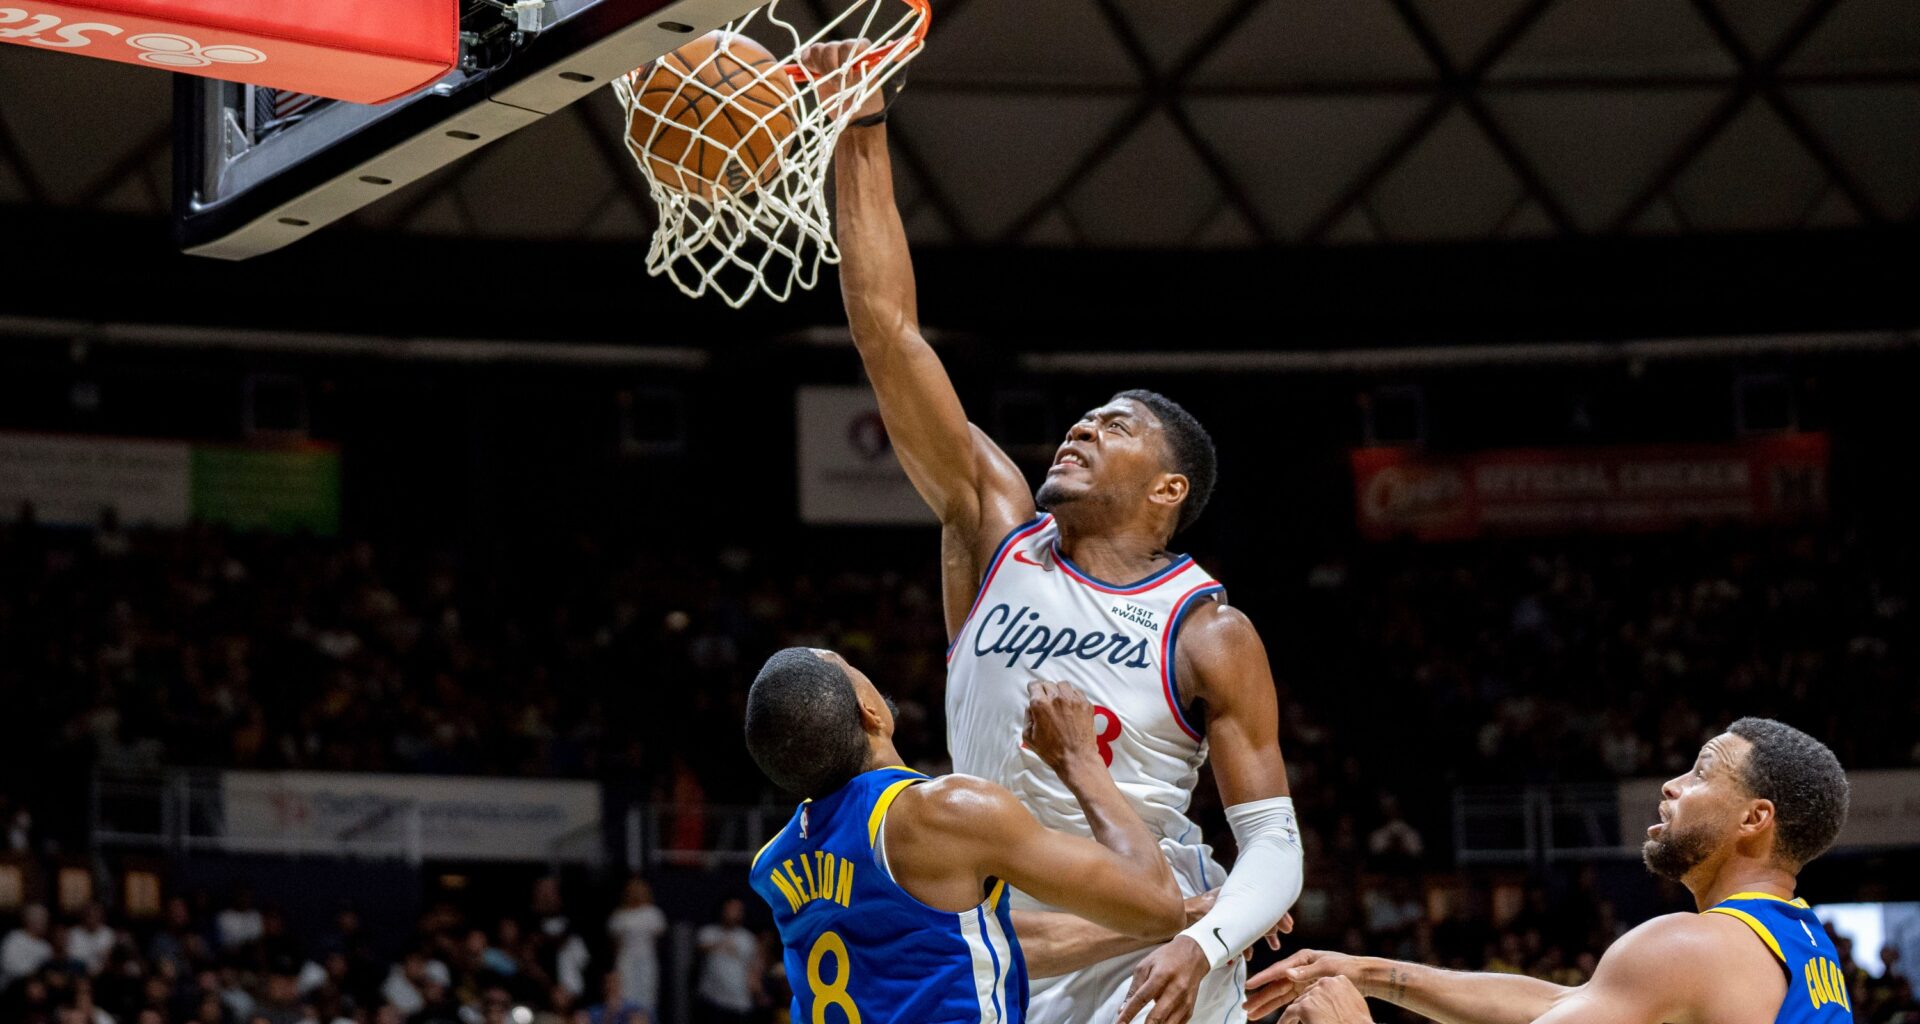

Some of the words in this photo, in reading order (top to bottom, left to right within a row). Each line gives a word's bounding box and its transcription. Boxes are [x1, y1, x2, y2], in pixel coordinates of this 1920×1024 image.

[975, 603, 1151, 669] Clippers
[1111, 606, 1158, 631] RWANDA
[1126, 603, 1154, 619] VISIT
[770, 850, 855, 914] MELTON
[807, 931, 862, 1024] 8
